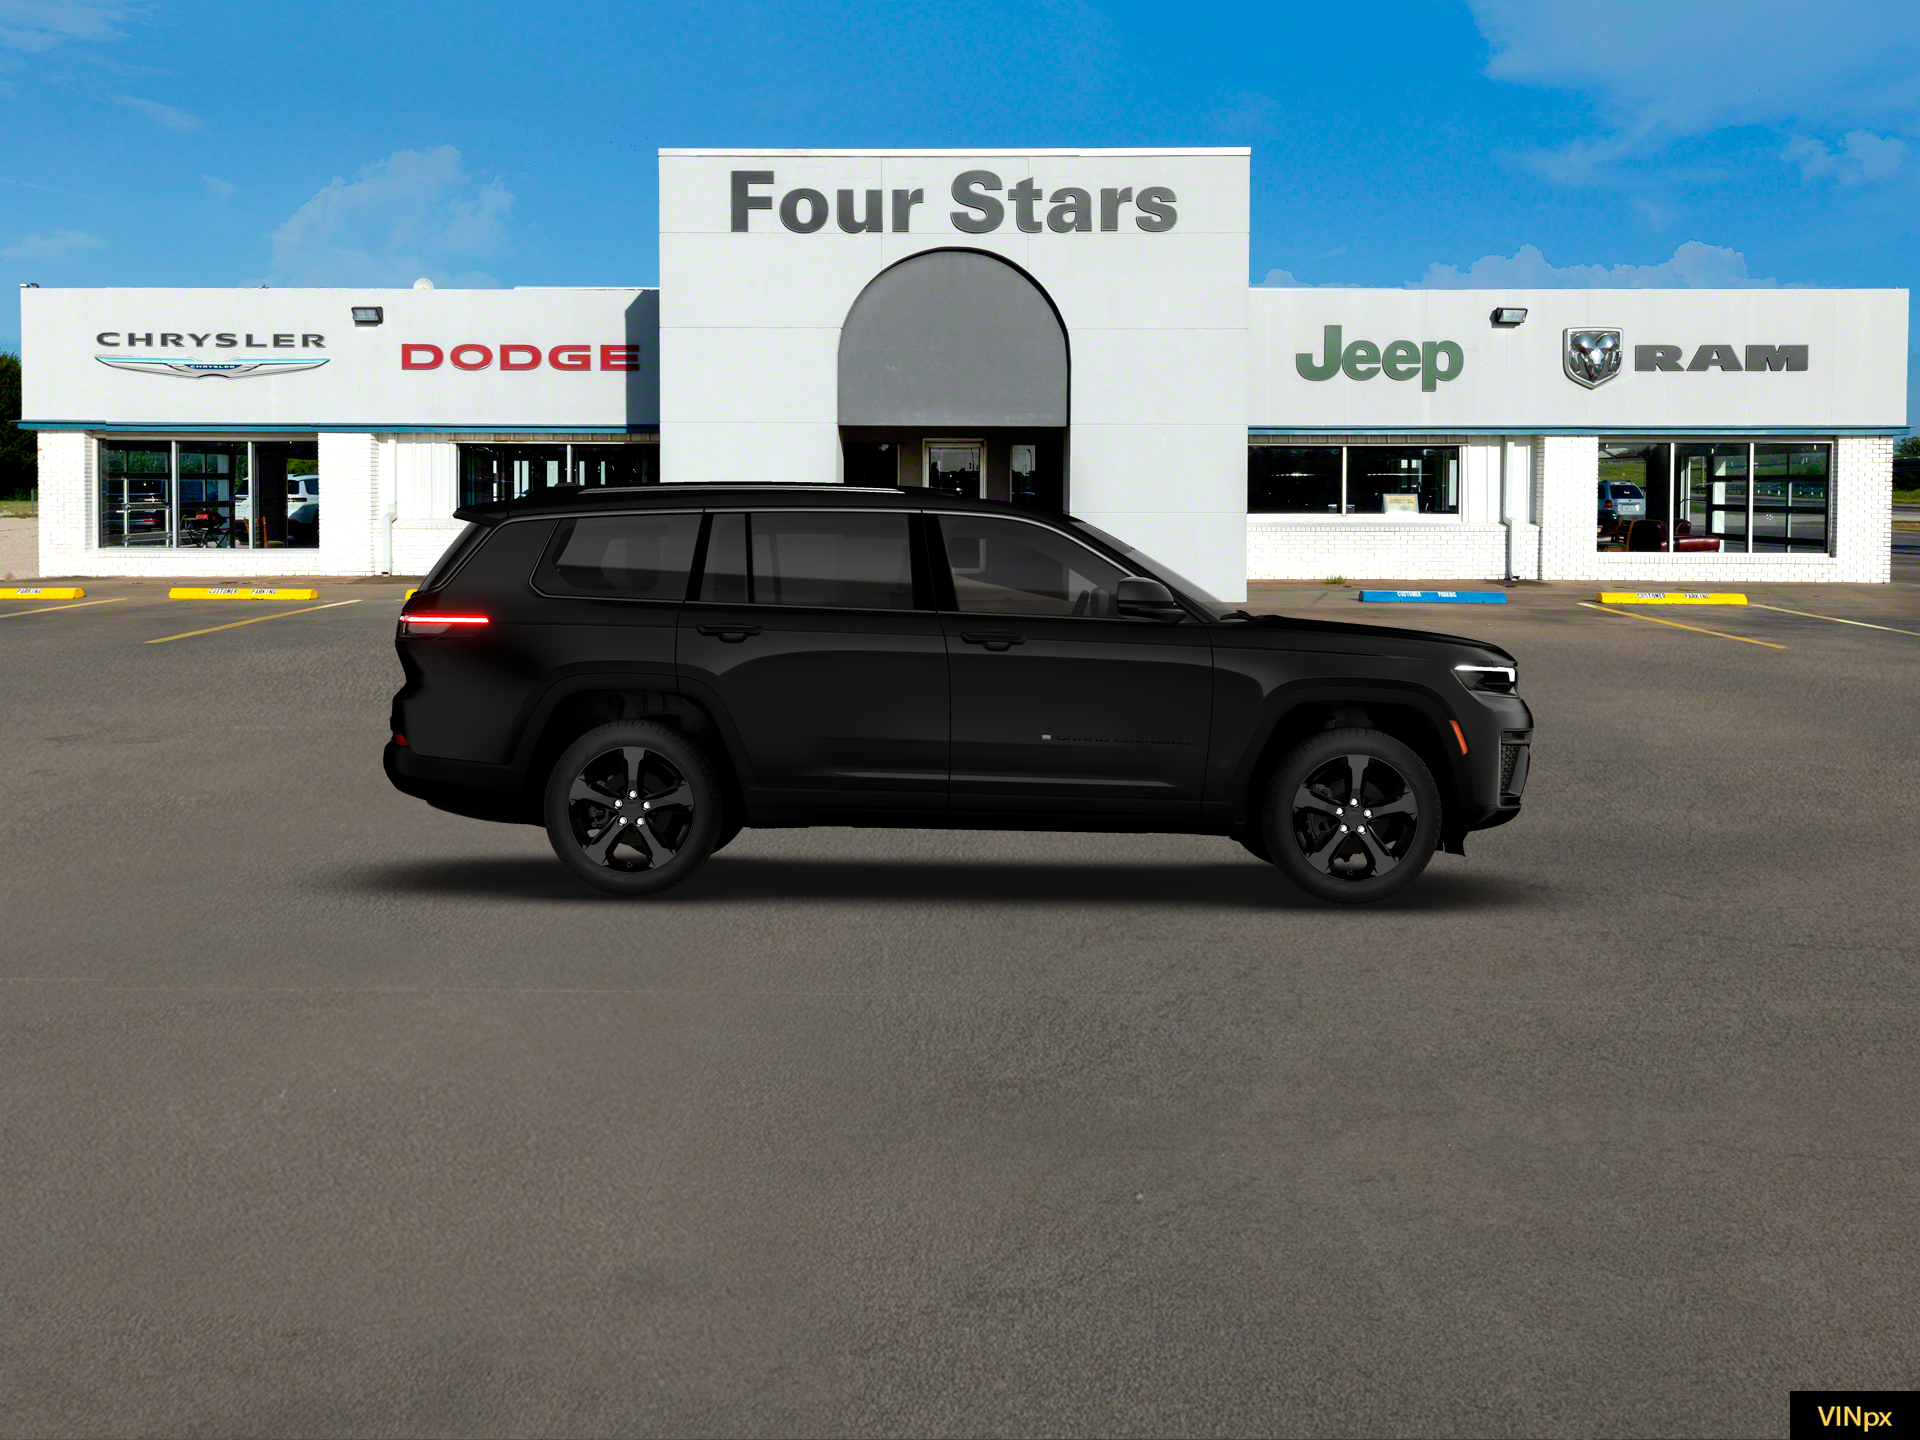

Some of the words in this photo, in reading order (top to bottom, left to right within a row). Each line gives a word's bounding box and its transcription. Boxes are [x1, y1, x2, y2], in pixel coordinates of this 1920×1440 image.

[730, 169, 925, 234] Four
[950, 169, 1178, 234] Stars
[96, 332, 327, 349] CHRYSLER
[401, 343, 640, 372] DODGE
[1295, 324, 1464, 393] Jeep
[1634, 343, 1809, 372] RAM
[1056, 734, 1110, 743] GRAND
[1114, 736, 1197, 746] CHEROKEE
